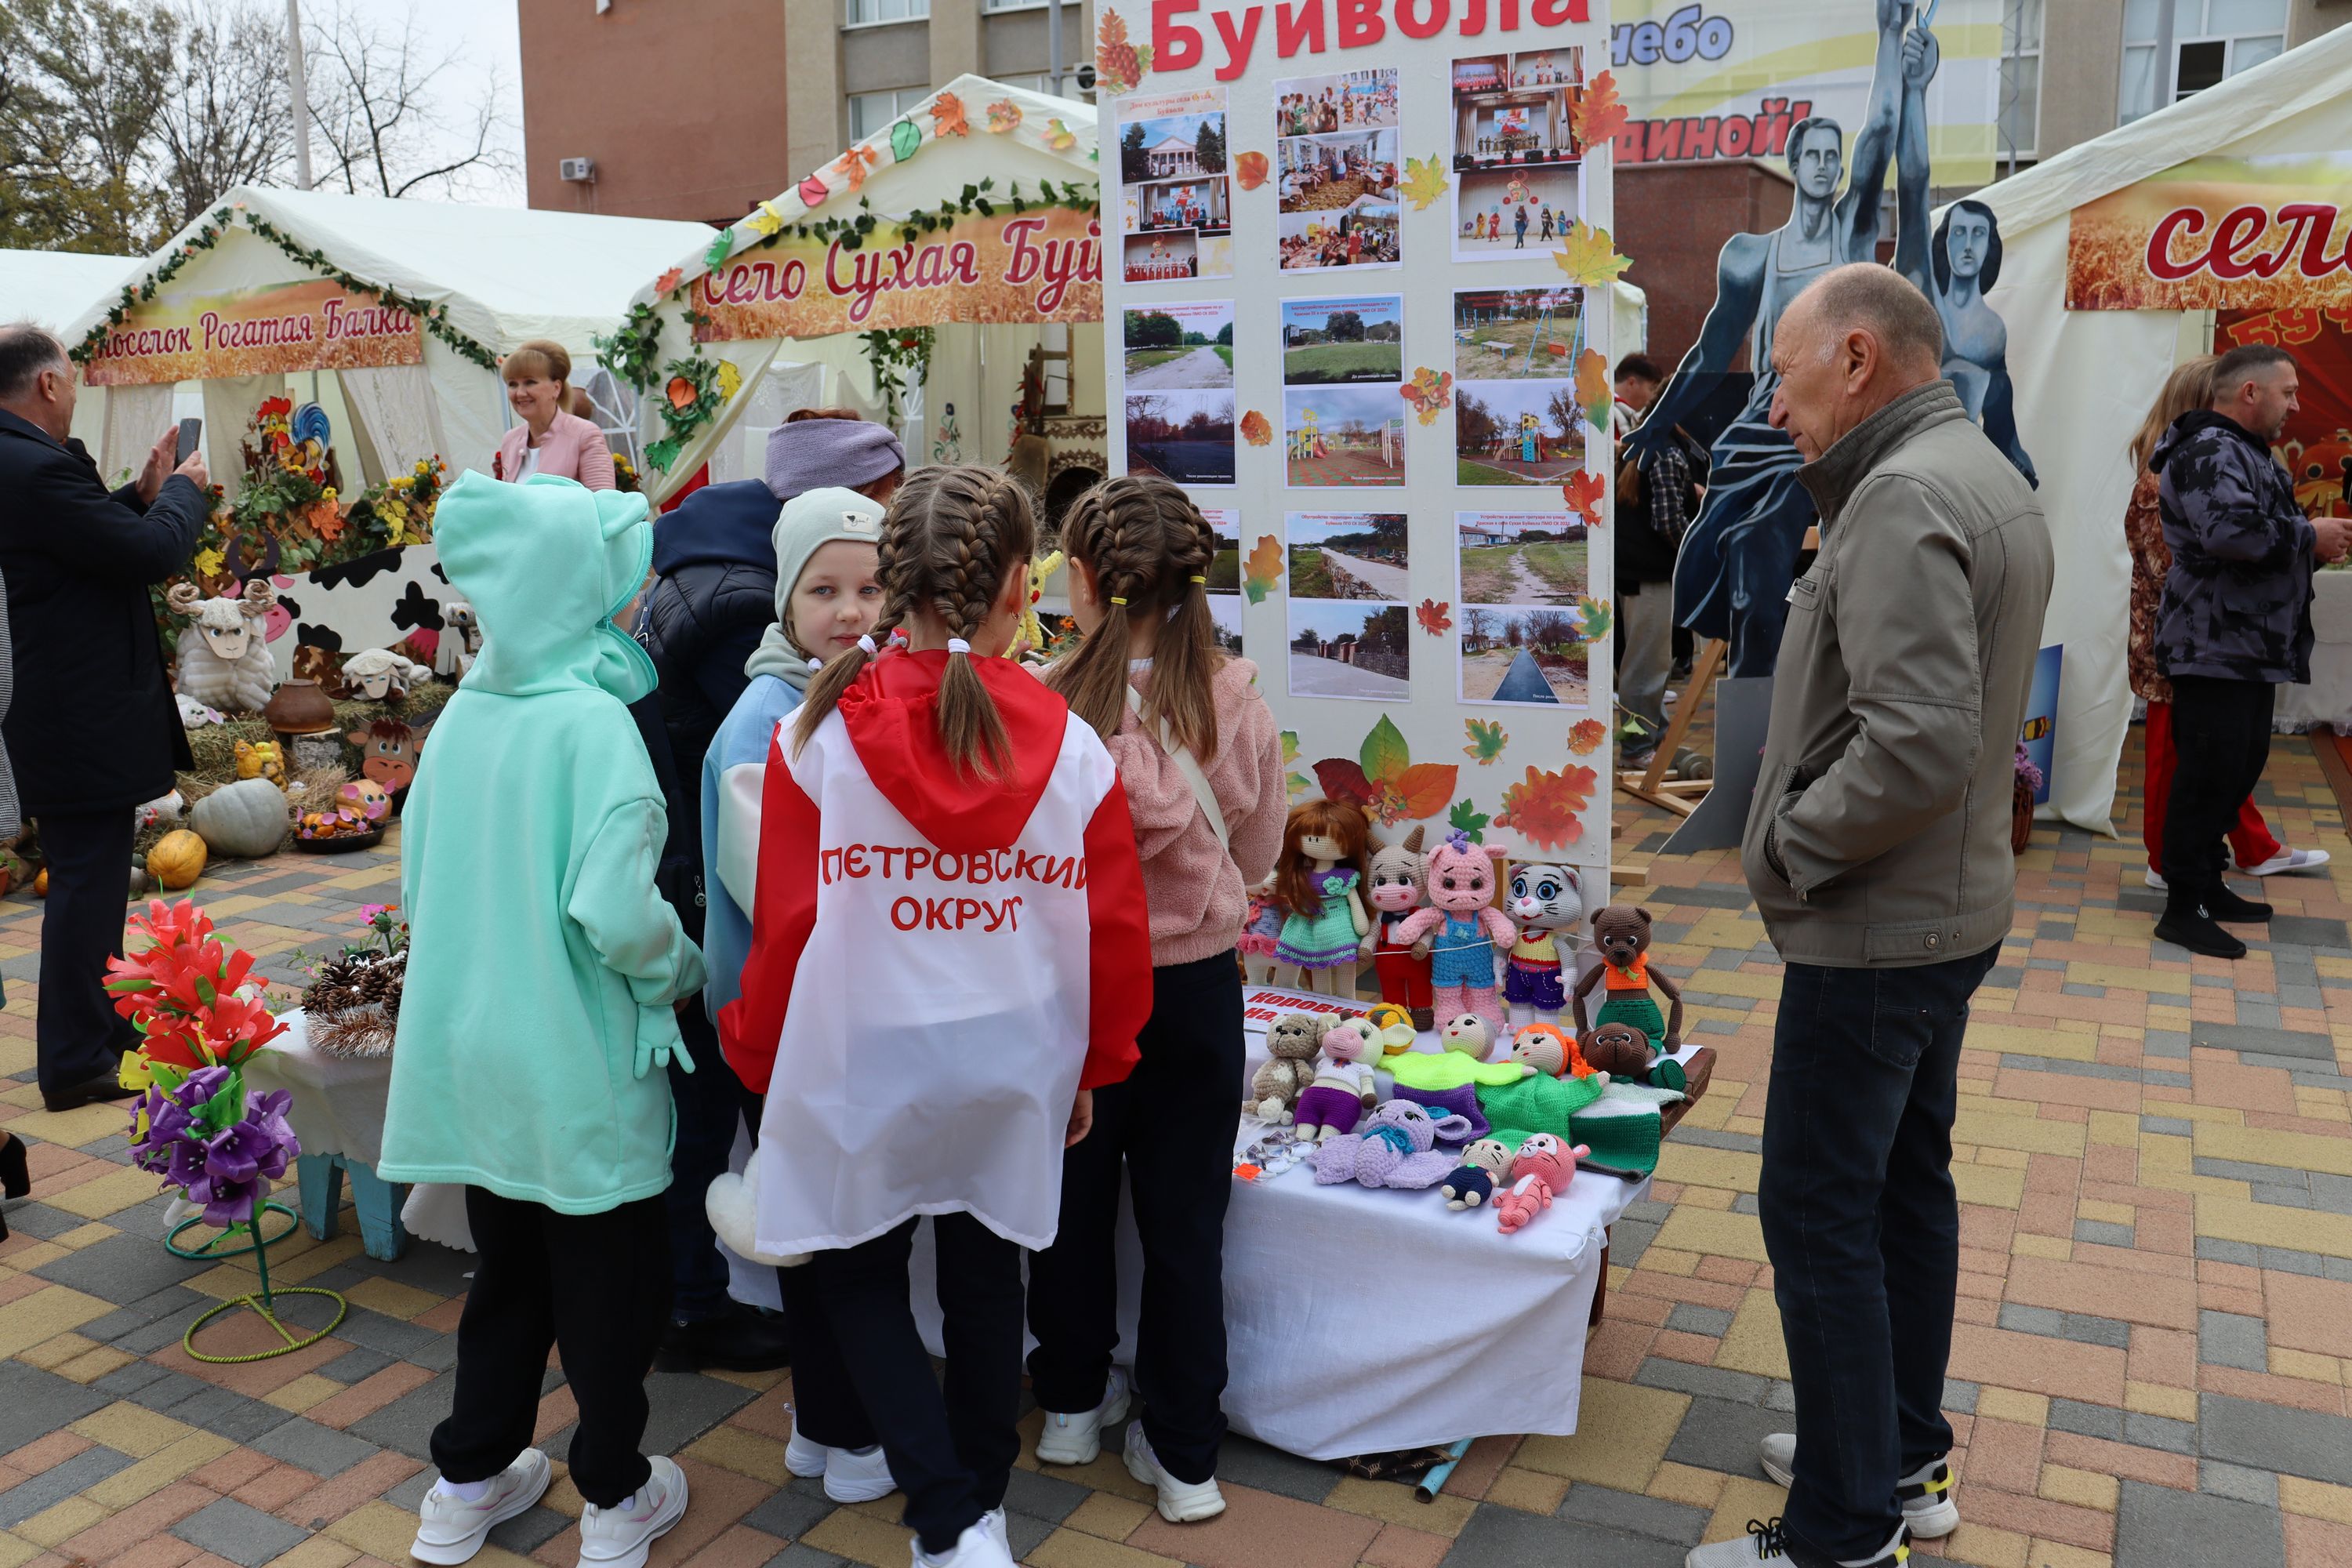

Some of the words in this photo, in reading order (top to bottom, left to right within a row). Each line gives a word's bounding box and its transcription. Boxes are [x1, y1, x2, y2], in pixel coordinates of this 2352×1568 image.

[1610, 3, 1734, 67] небо
[2147, 203, 2352, 280] сел
[704, 260, 806, 307] село
[825, 238, 979, 323] Сухая
[199, 311, 313, 350] Рогатая
[322, 297, 414, 340] Балка
[2227, 307, 2352, 347] БУ
[891, 895, 1023, 932] ОКРУГ
